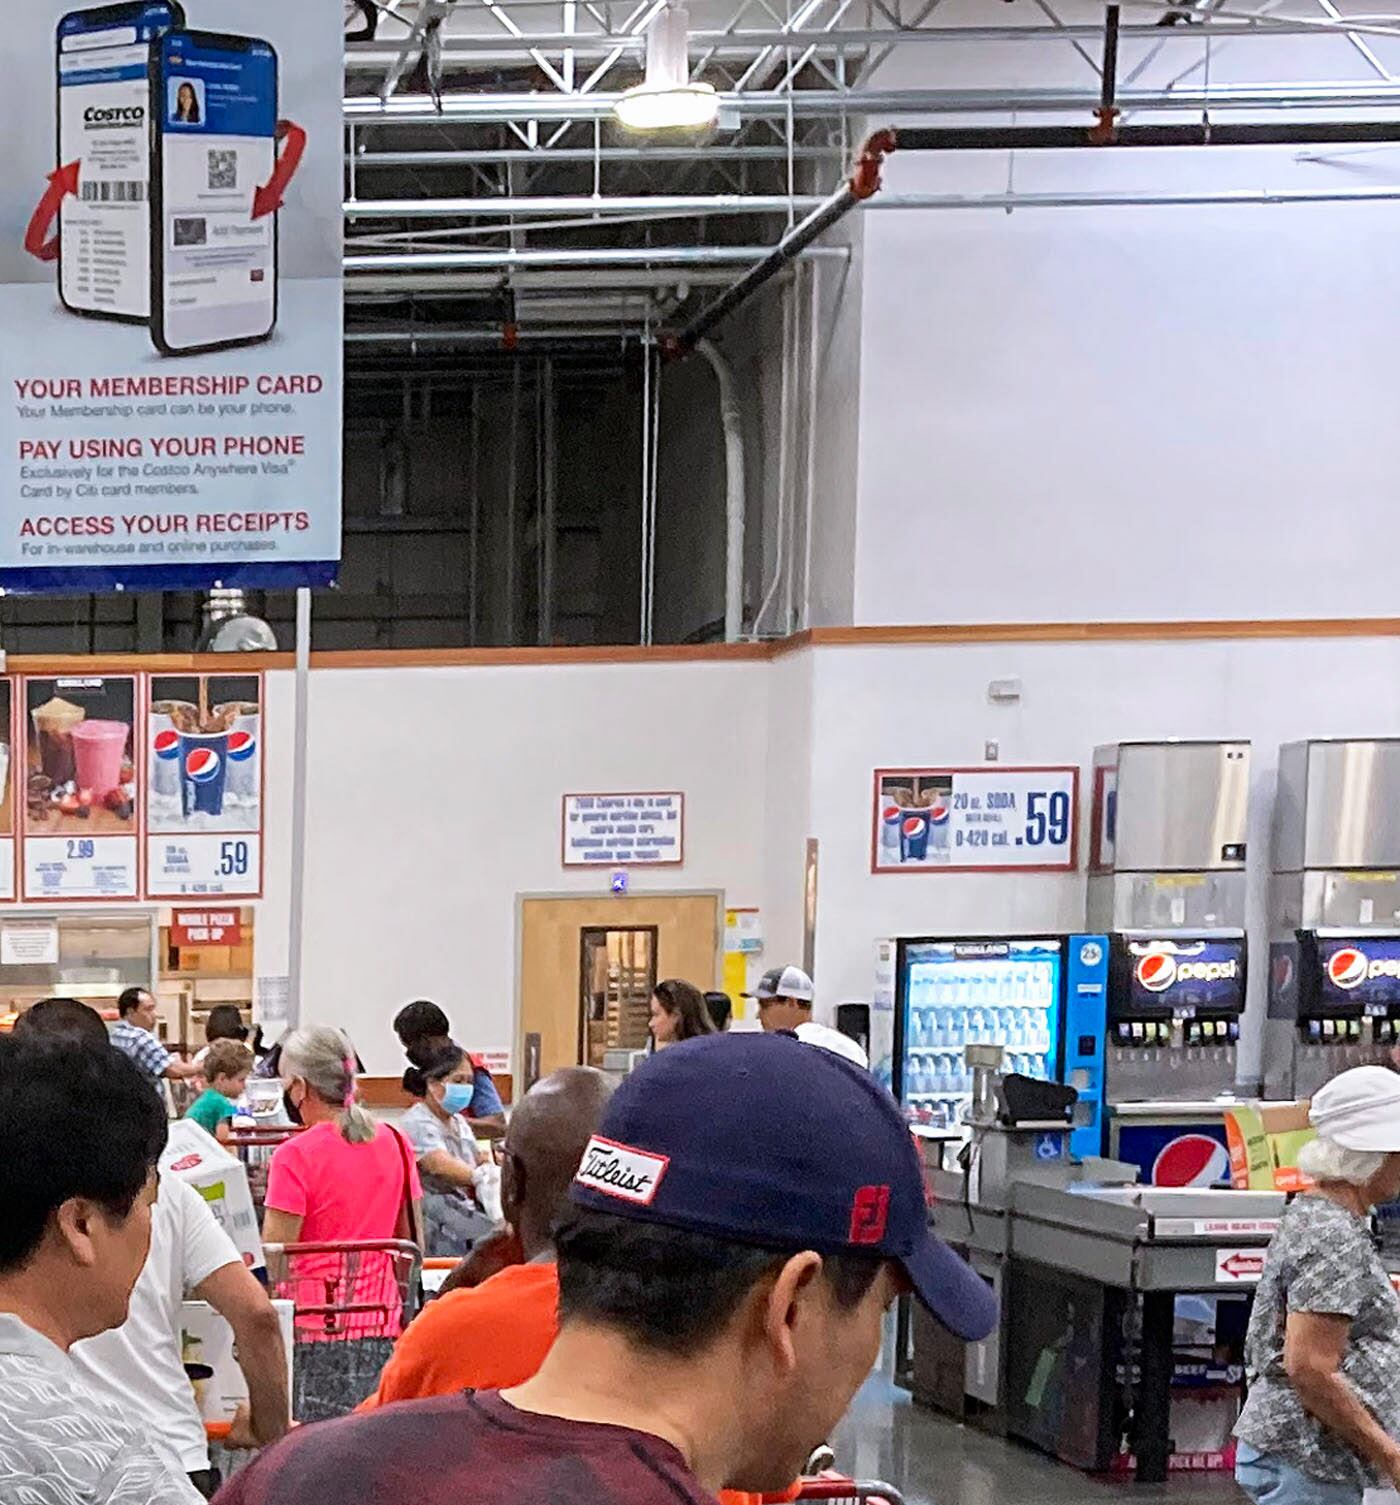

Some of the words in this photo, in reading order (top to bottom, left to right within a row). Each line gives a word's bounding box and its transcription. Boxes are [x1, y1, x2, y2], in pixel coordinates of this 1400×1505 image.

[84, 106, 144, 122] COSTCO
[15, 378, 81, 399] YOUR
[91, 375, 249, 396] MEMBERSHIP
[257, 374, 323, 394] CARD
[17, 406, 45, 419] Your
[51, 403, 132, 418] Membership
[136, 404, 167, 416] card
[170, 404, 194, 415] can
[198, 403, 215, 415] be
[218, 403, 246, 417] your
[250, 401, 295, 415] phone.
[20, 440, 61, 460] PAY
[70, 438, 142, 459] USING
[150, 437, 216, 457] YOUR
[224, 435, 305, 456] PHONE
[20, 464, 92, 480] Exclusively
[96, 463, 113, 477] for
[118, 463, 139, 477] the
[143, 463, 189, 476] Costco
[193, 462, 258, 477] Anywhere
[20, 485, 52, 498] Card
[56, 484, 72, 500] by
[102, 483, 131, 496] card
[135, 482, 199, 496] members.
[20, 516, 114, 537] ACCESS
[122, 514, 188, 535] YOUR
[197, 512, 310, 533] RECEIPTS
[21, 542, 43, 556] For
[139, 540, 164, 553] and
[168, 540, 207, 554] online
[954, 793, 968, 809] 20
[987, 792, 1016, 809] SODA
[1016, 791, 1070, 846] .59
[67, 840, 94, 859] 2.99
[214, 842, 247, 876] .59
[1177, 959, 1236, 982] pepsi
[580, 1146, 652, 1194] Titleist
